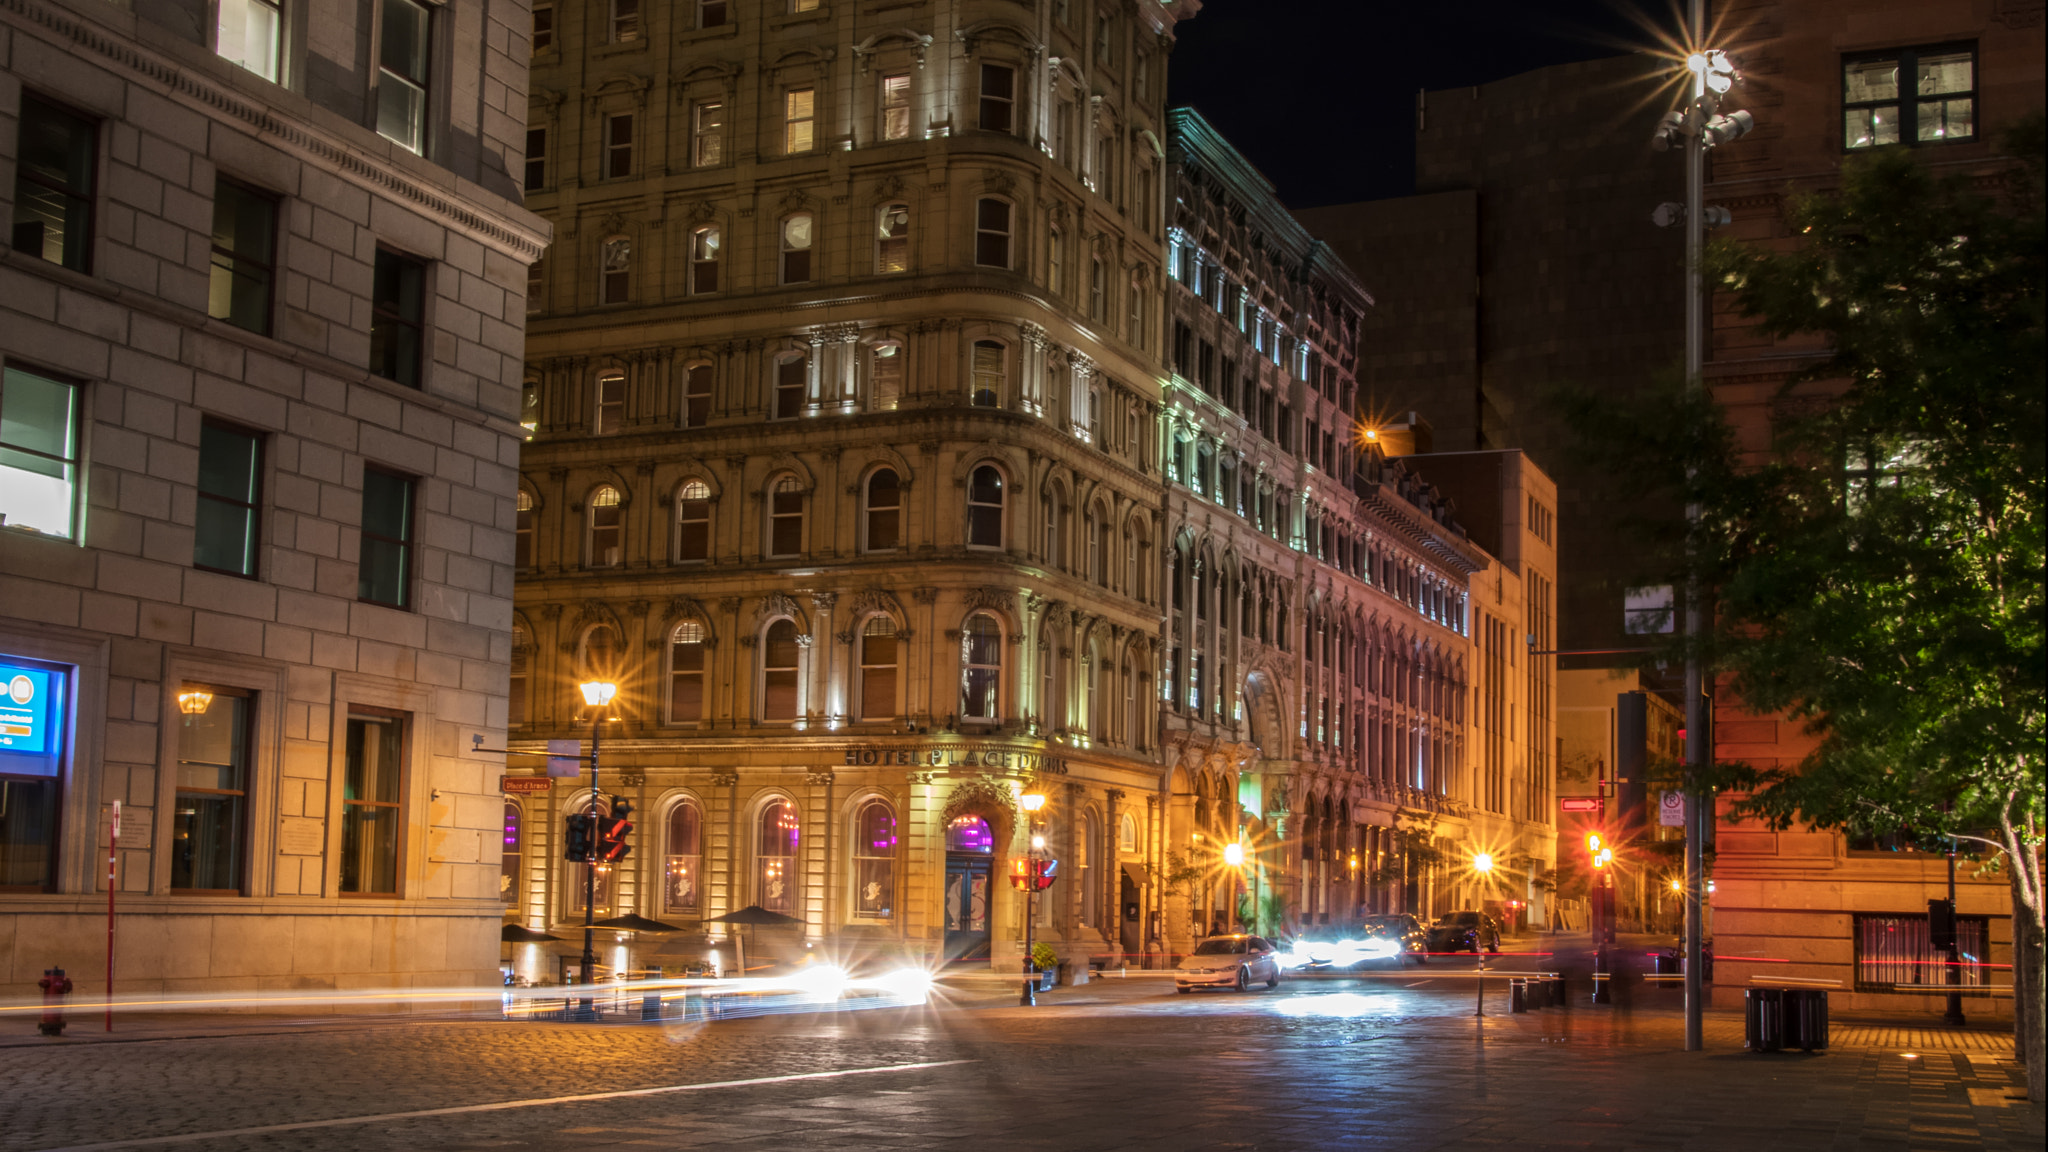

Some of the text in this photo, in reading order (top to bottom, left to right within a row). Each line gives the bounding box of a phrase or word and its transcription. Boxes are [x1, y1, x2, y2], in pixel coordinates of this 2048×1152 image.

[845, 749, 920, 766] HOTEL
[931, 749, 1011, 767] PLACE
[506, 781, 523, 790] Place
